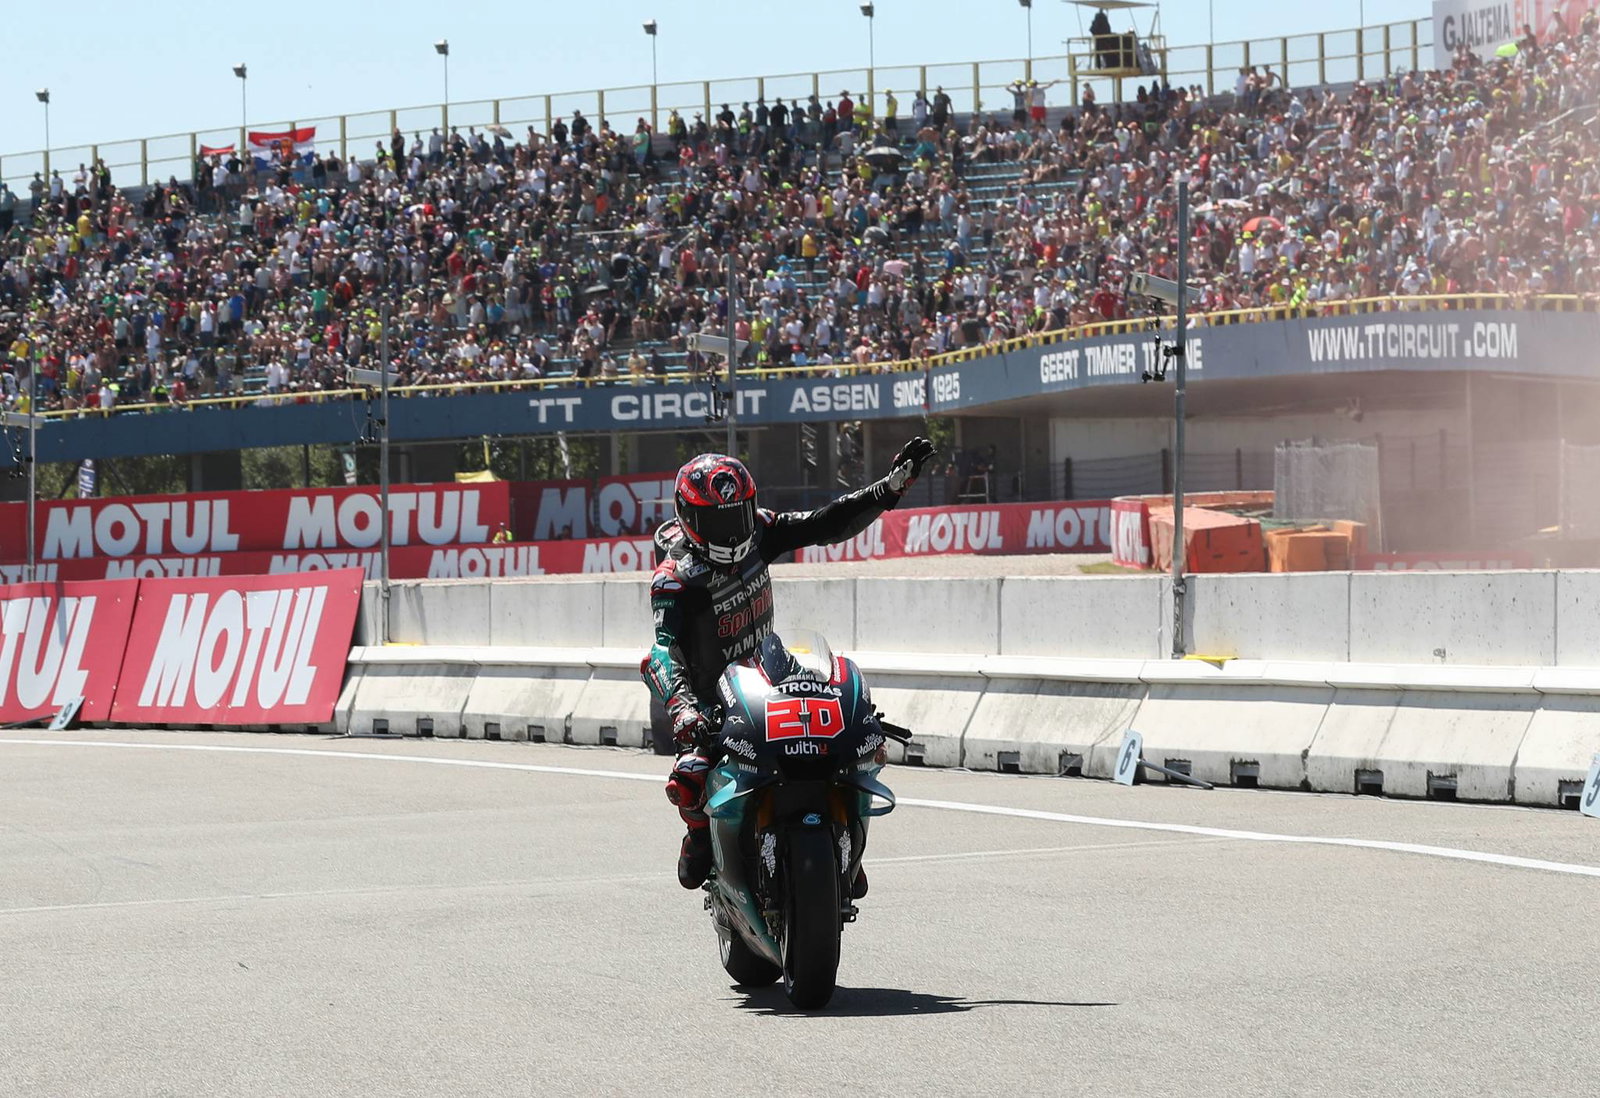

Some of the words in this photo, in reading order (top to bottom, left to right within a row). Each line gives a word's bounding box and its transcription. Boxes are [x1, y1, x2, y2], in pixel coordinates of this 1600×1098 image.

[1040, 349, 1079, 383] GEERT
[1085, 343, 1136, 376] TIMMER
[529, 397, 582, 424] TT
[789, 383, 880, 413] ASSEN
[893, 379, 926, 408] SINCE
[932, 371, 960, 403] 1925
[42, 499, 240, 560] MOTUL
[283, 489, 490, 549] MOTUL
[904, 510, 1004, 554] MOTUL
[428, 545, 545, 579] MOTUL
[0, 596, 97, 710] TUL
[137, 585, 328, 710] MOTUL
[762, 681, 843, 698] ETRONAS
[764, 697, 846, 743] 20
[722, 736, 758, 760] Malaysia
[1119, 739, 1137, 776] 6
